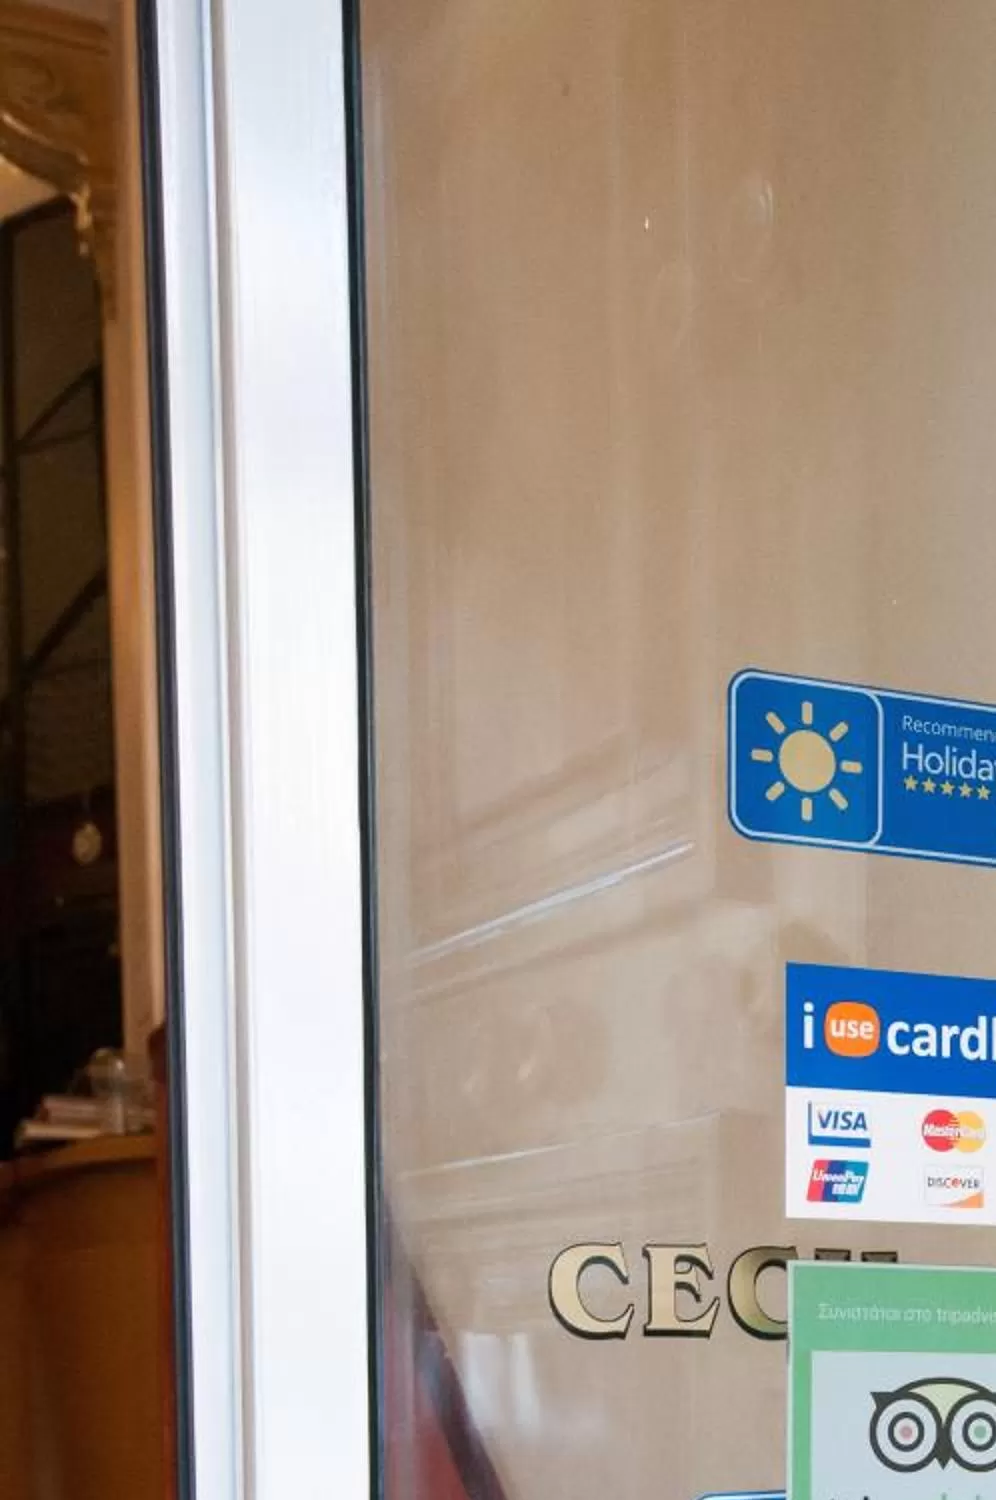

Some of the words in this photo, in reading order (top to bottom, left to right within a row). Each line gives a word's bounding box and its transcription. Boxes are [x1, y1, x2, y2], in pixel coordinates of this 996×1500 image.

[803, 1001, 815, 1049] i
[830, 1018, 874, 1041] use
[818, 1110, 868, 1131] VISA
[927, 1175, 981, 1189] DISCOVER
[548, 1242, 898, 1340] CEC
